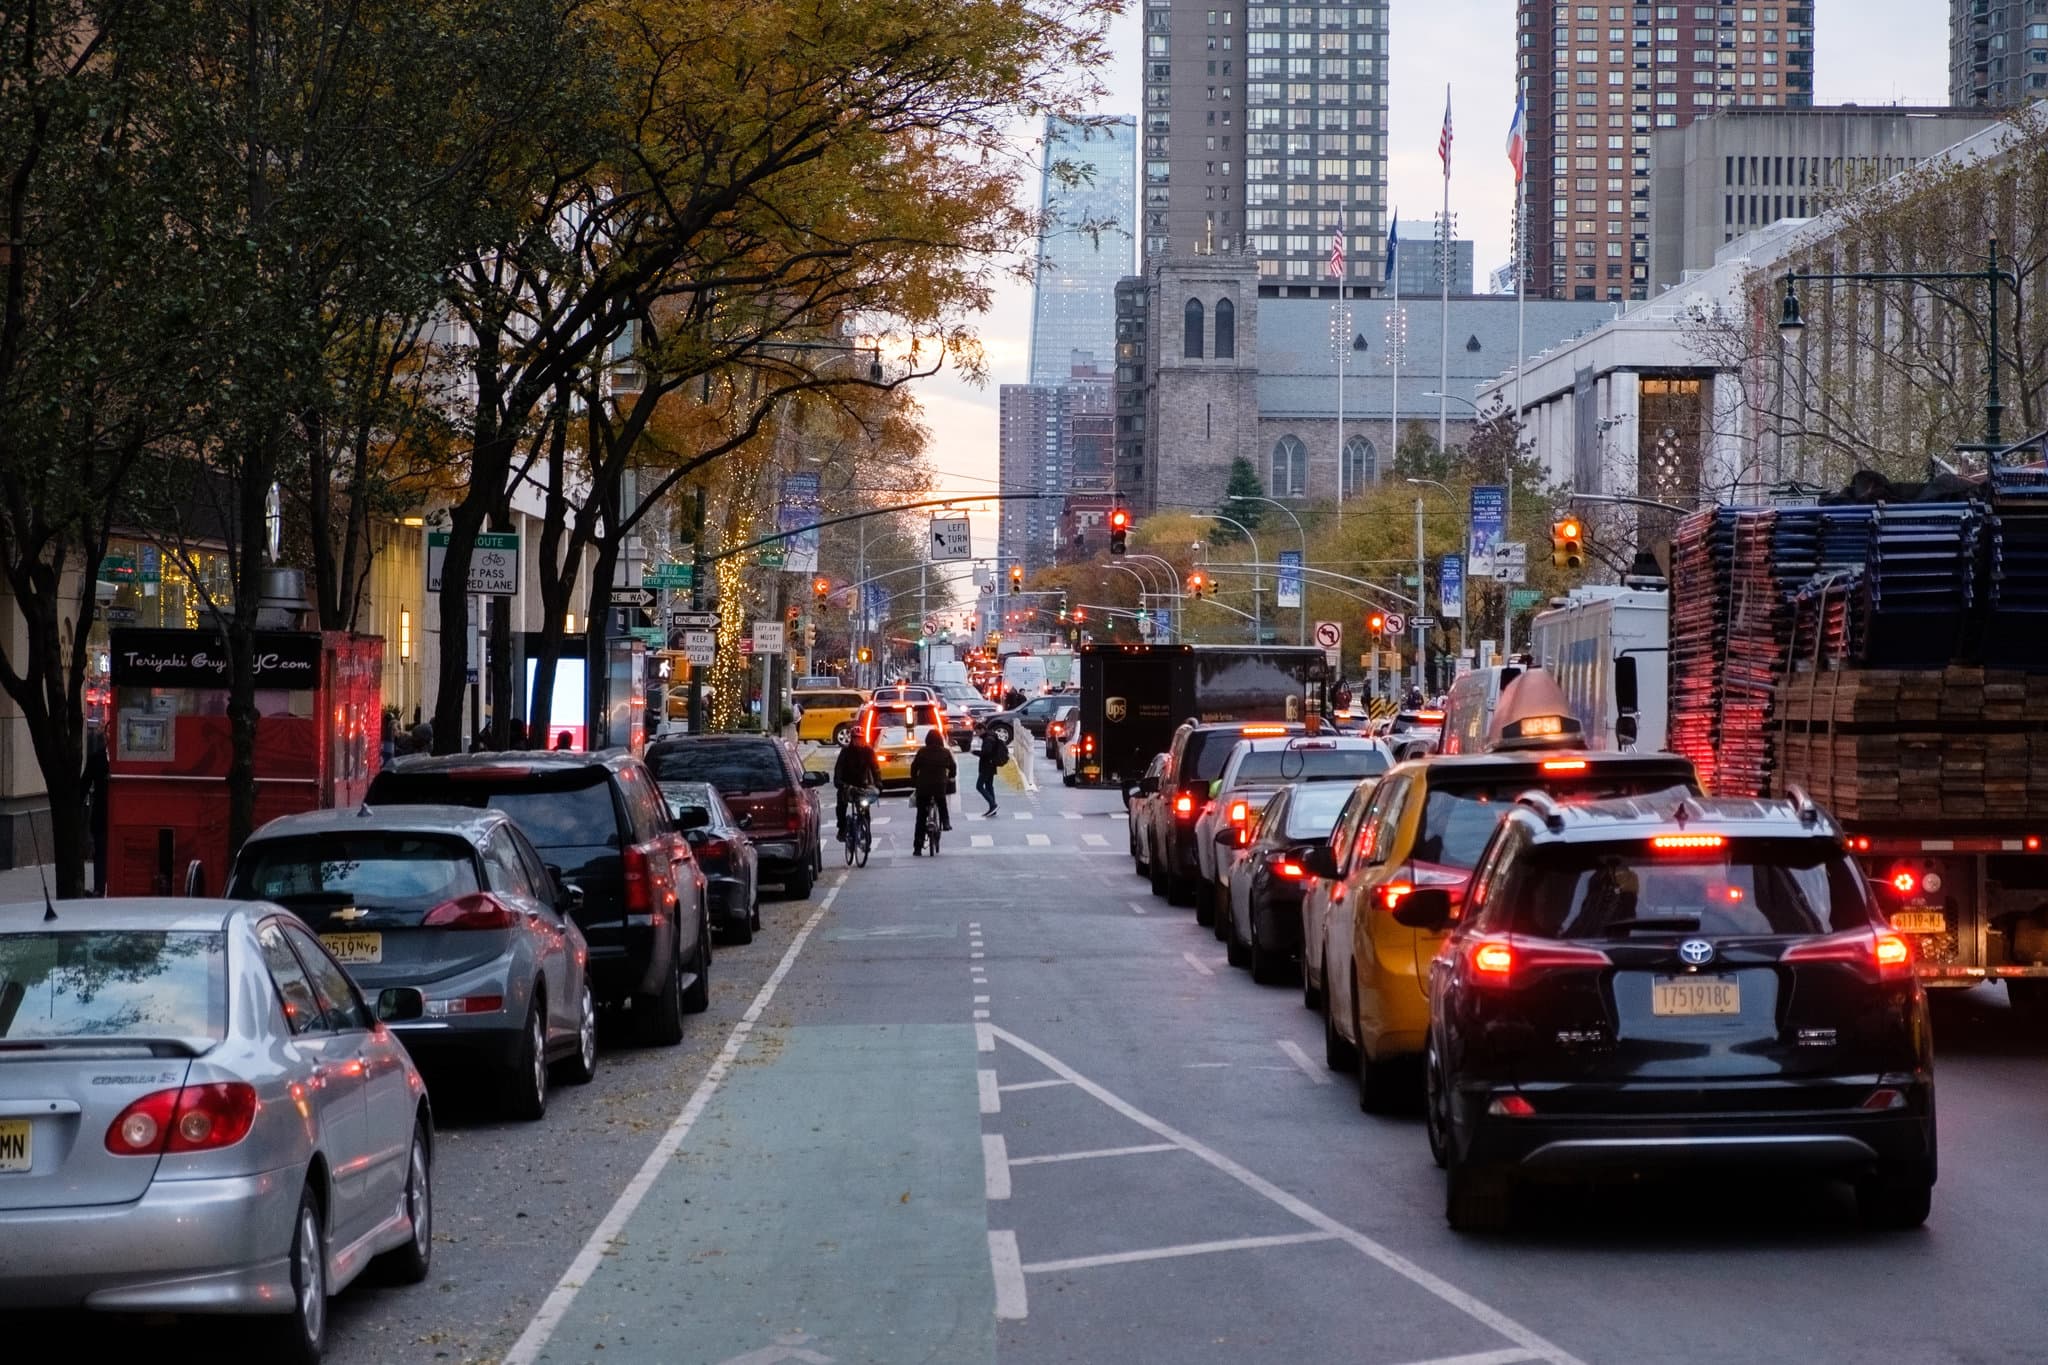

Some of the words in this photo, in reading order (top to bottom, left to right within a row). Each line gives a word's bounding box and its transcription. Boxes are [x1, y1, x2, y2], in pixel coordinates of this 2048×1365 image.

[948, 523, 966, 532] LEFT
[475, 536, 504, 547] OUTE
[948, 535, 968, 543] TURN
[948, 545, 968, 554] LANE
[480, 568, 504, 579] PASS
[487, 580, 513, 590] LANE
[643, 577, 661, 585] PETER
[664, 577, 691, 585] JENNINGS
[700, 616, 715, 624] WAY
[692, 635, 708, 643] KEEP
[124, 651, 187, 672] Teriyaki
[191, 652, 227, 674] Guy
[252, 653, 312, 674] YC.com
[689, 654, 710, 662] CLEAR
[92, 1075, 156, 1086] COROLLA
